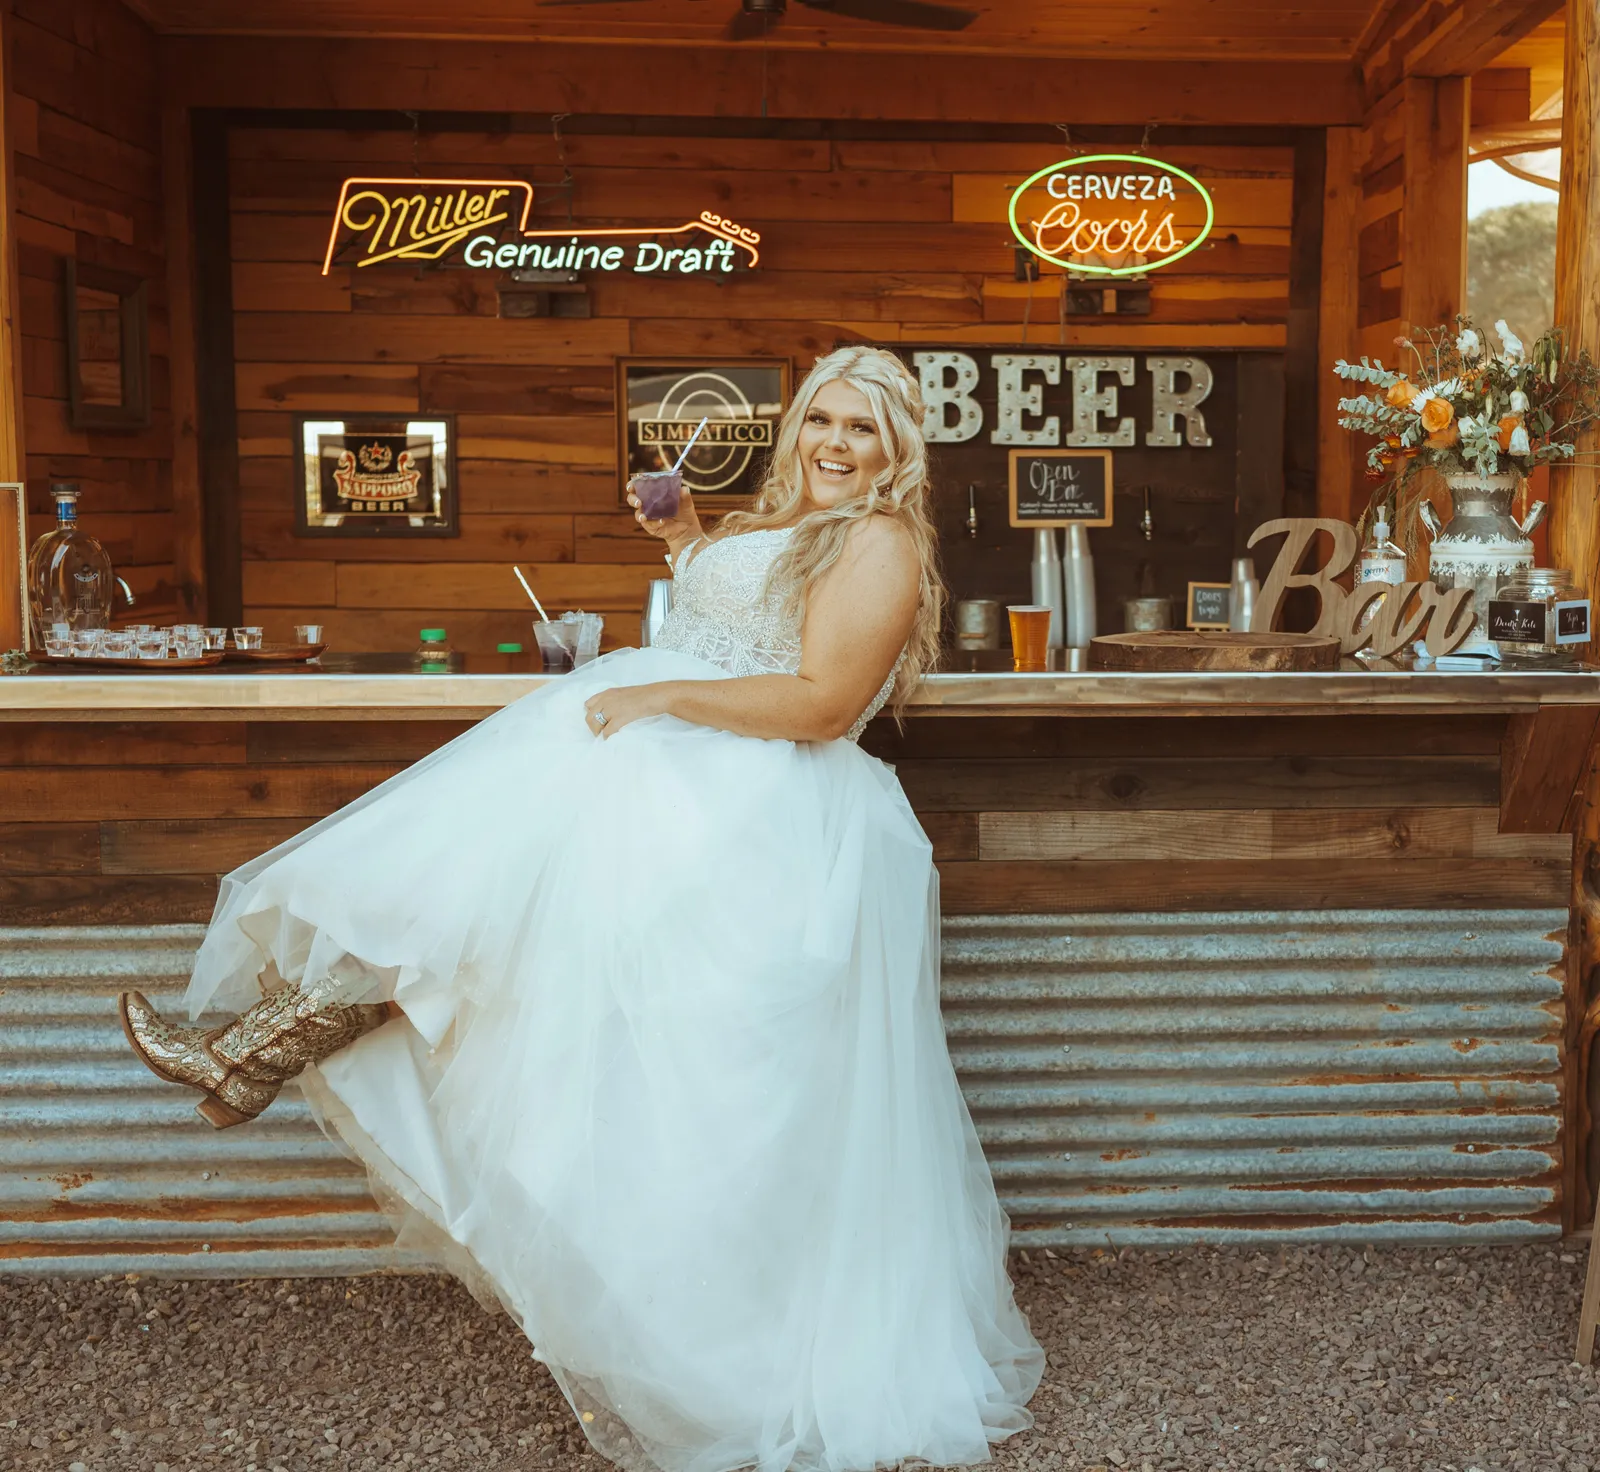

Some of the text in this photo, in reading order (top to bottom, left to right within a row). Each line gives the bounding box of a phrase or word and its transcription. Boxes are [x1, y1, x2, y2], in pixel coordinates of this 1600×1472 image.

[1047, 173, 1176, 201] CERVEZA
[342, 189, 509, 253] Miller
[1031, 202, 1183, 254] Coors
[464, 235, 736, 273] Genuine Draft
[913, 352, 1213, 447] BEER
[643, 423, 766, 441] SIMPATICO
[342, 479, 414, 497] SAPPORO
[351, 501, 404, 512] BEER
[1246, 517, 1478, 658] Bar
